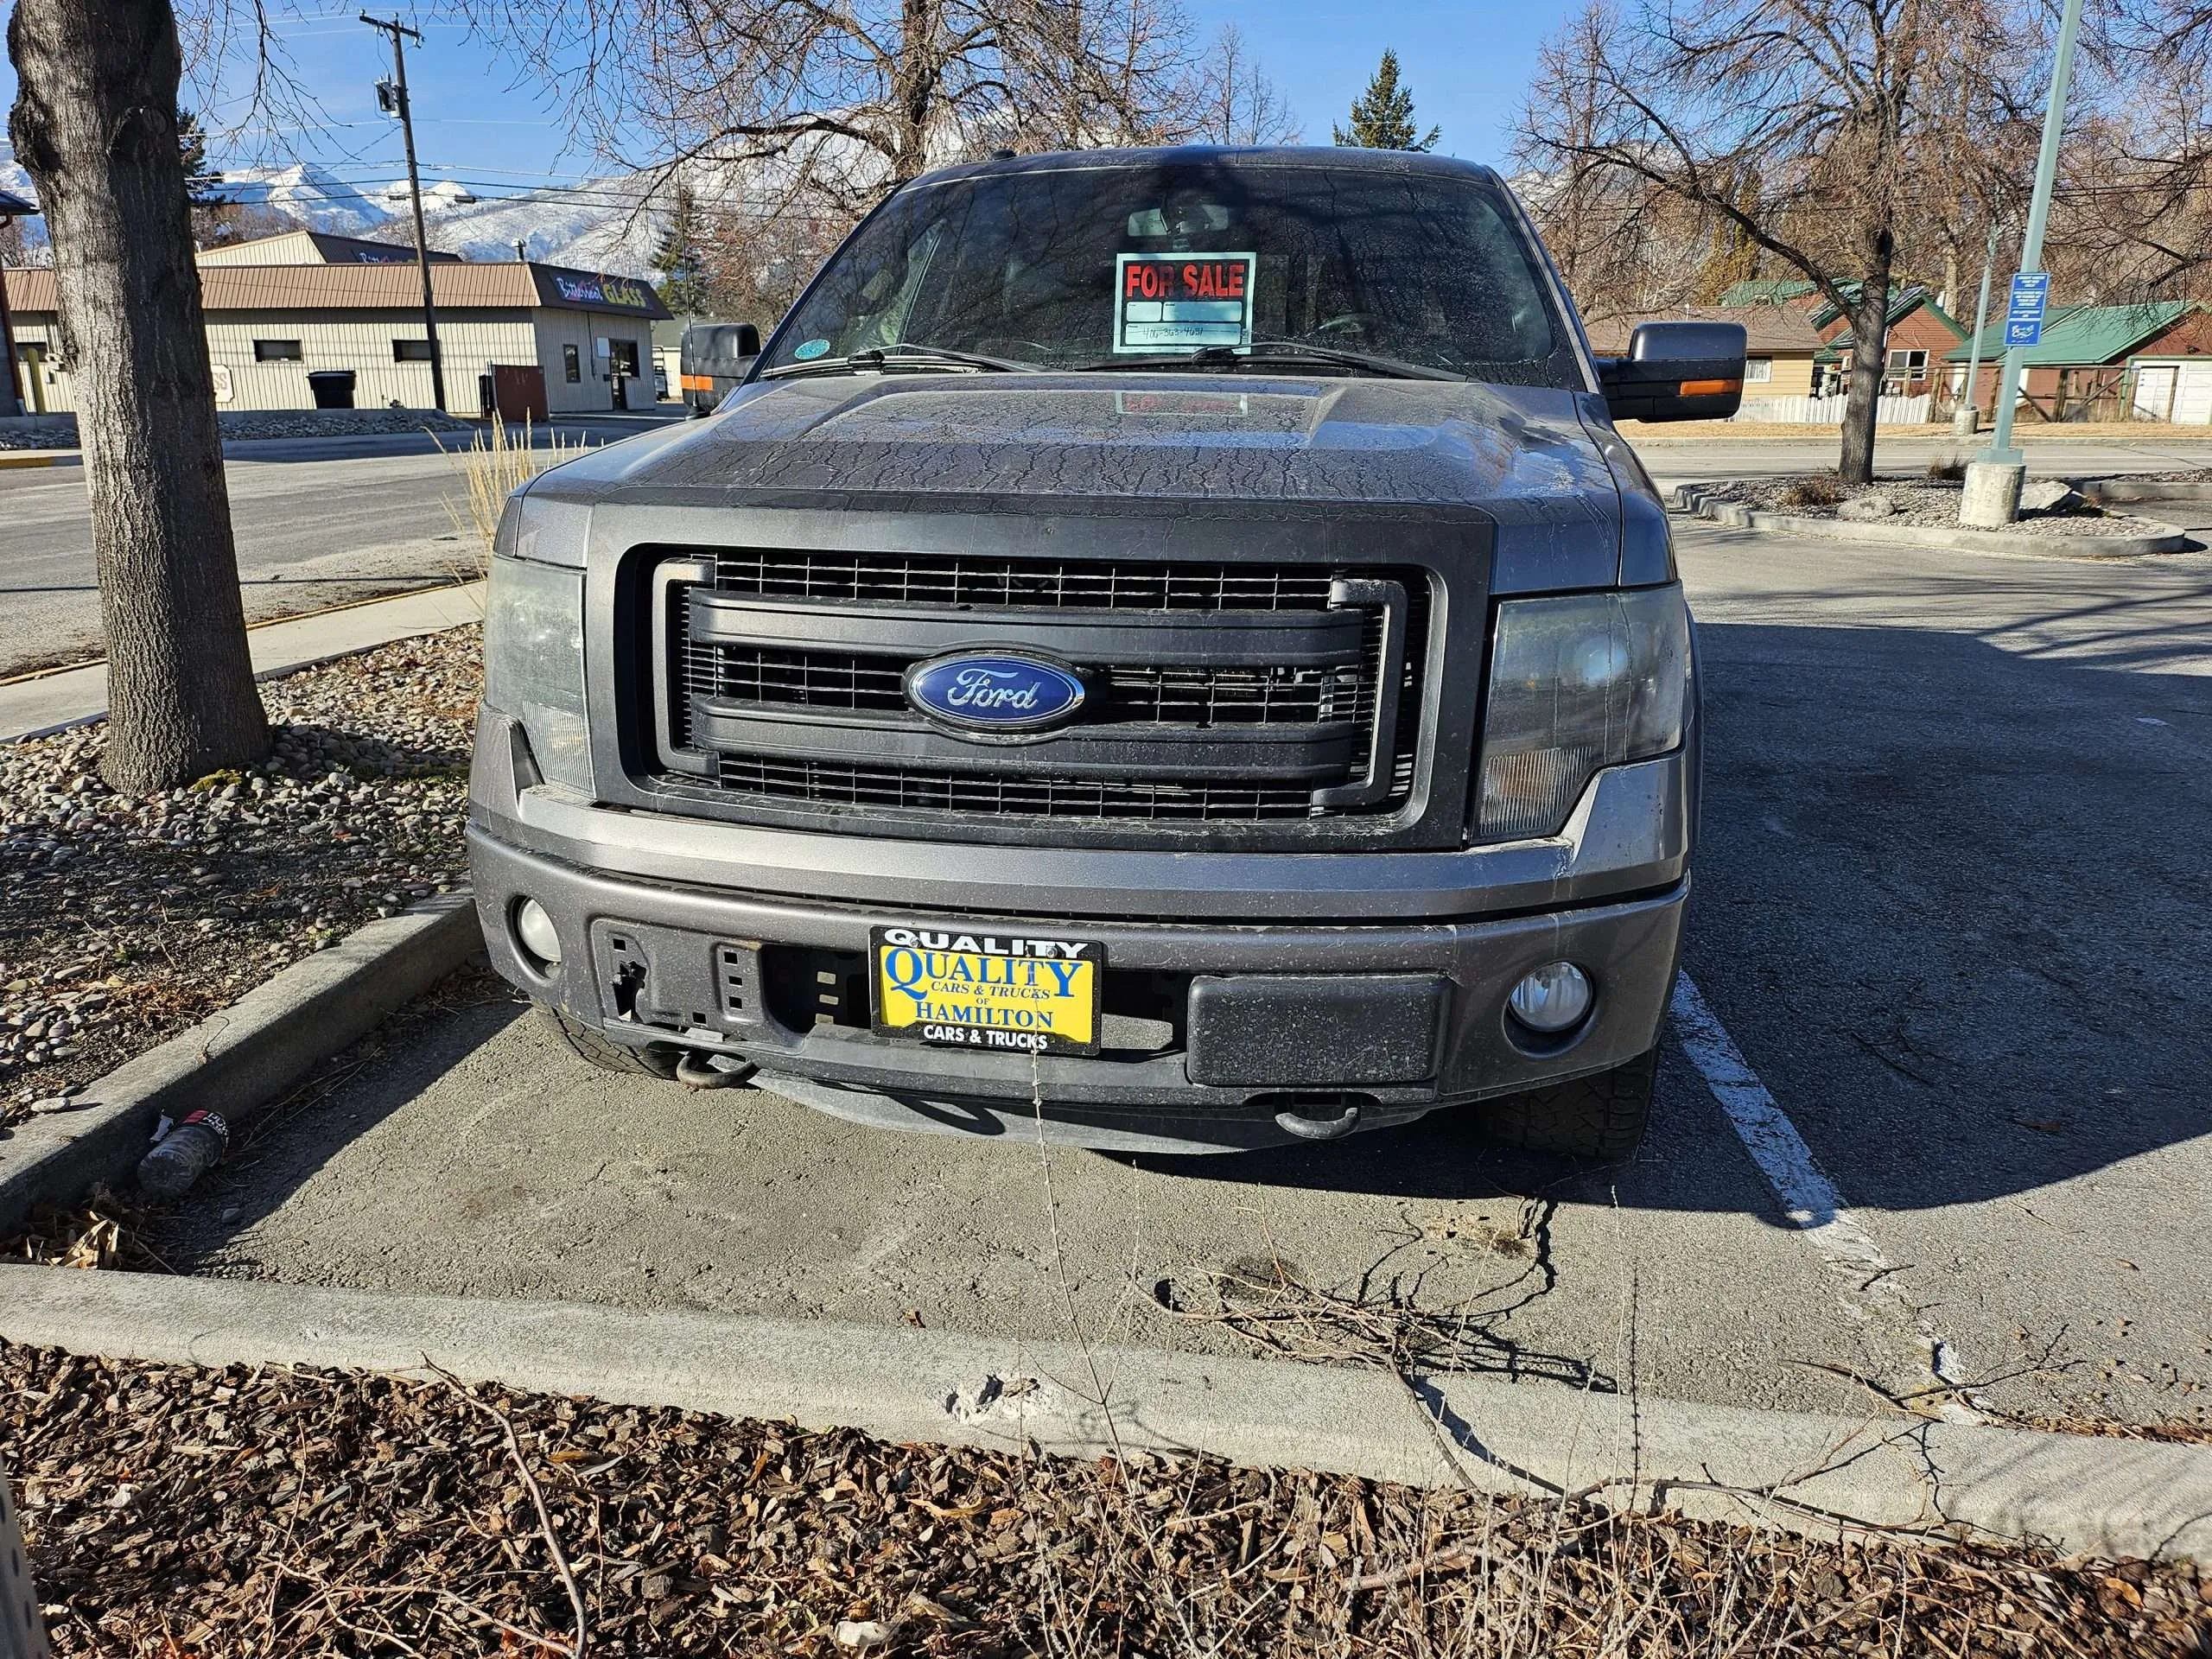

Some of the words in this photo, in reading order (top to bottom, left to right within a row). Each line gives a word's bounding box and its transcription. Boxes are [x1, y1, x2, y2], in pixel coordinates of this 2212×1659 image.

[1126, 265, 1175, 298] FOR
[1183, 264, 1245, 297] SALE
[603, 284, 645, 307] GLASS
[947, 668, 1044, 709] Ford
[883, 928, 1089, 959] QUALITY
[884, 947, 1083, 1001] QUALITY
[931, 981, 970, 995] CARS
[973, 985, 985, 995] &
[988, 986, 1051, 1000] TRUCKS
[976, 997, 990, 1006] OF
[914, 1001, 1054, 1029] HAMILTON
[923, 1024, 966, 1042] CARS
[969, 1028, 982, 1044] &
[985, 1030, 1048, 1051] TRUCKS
